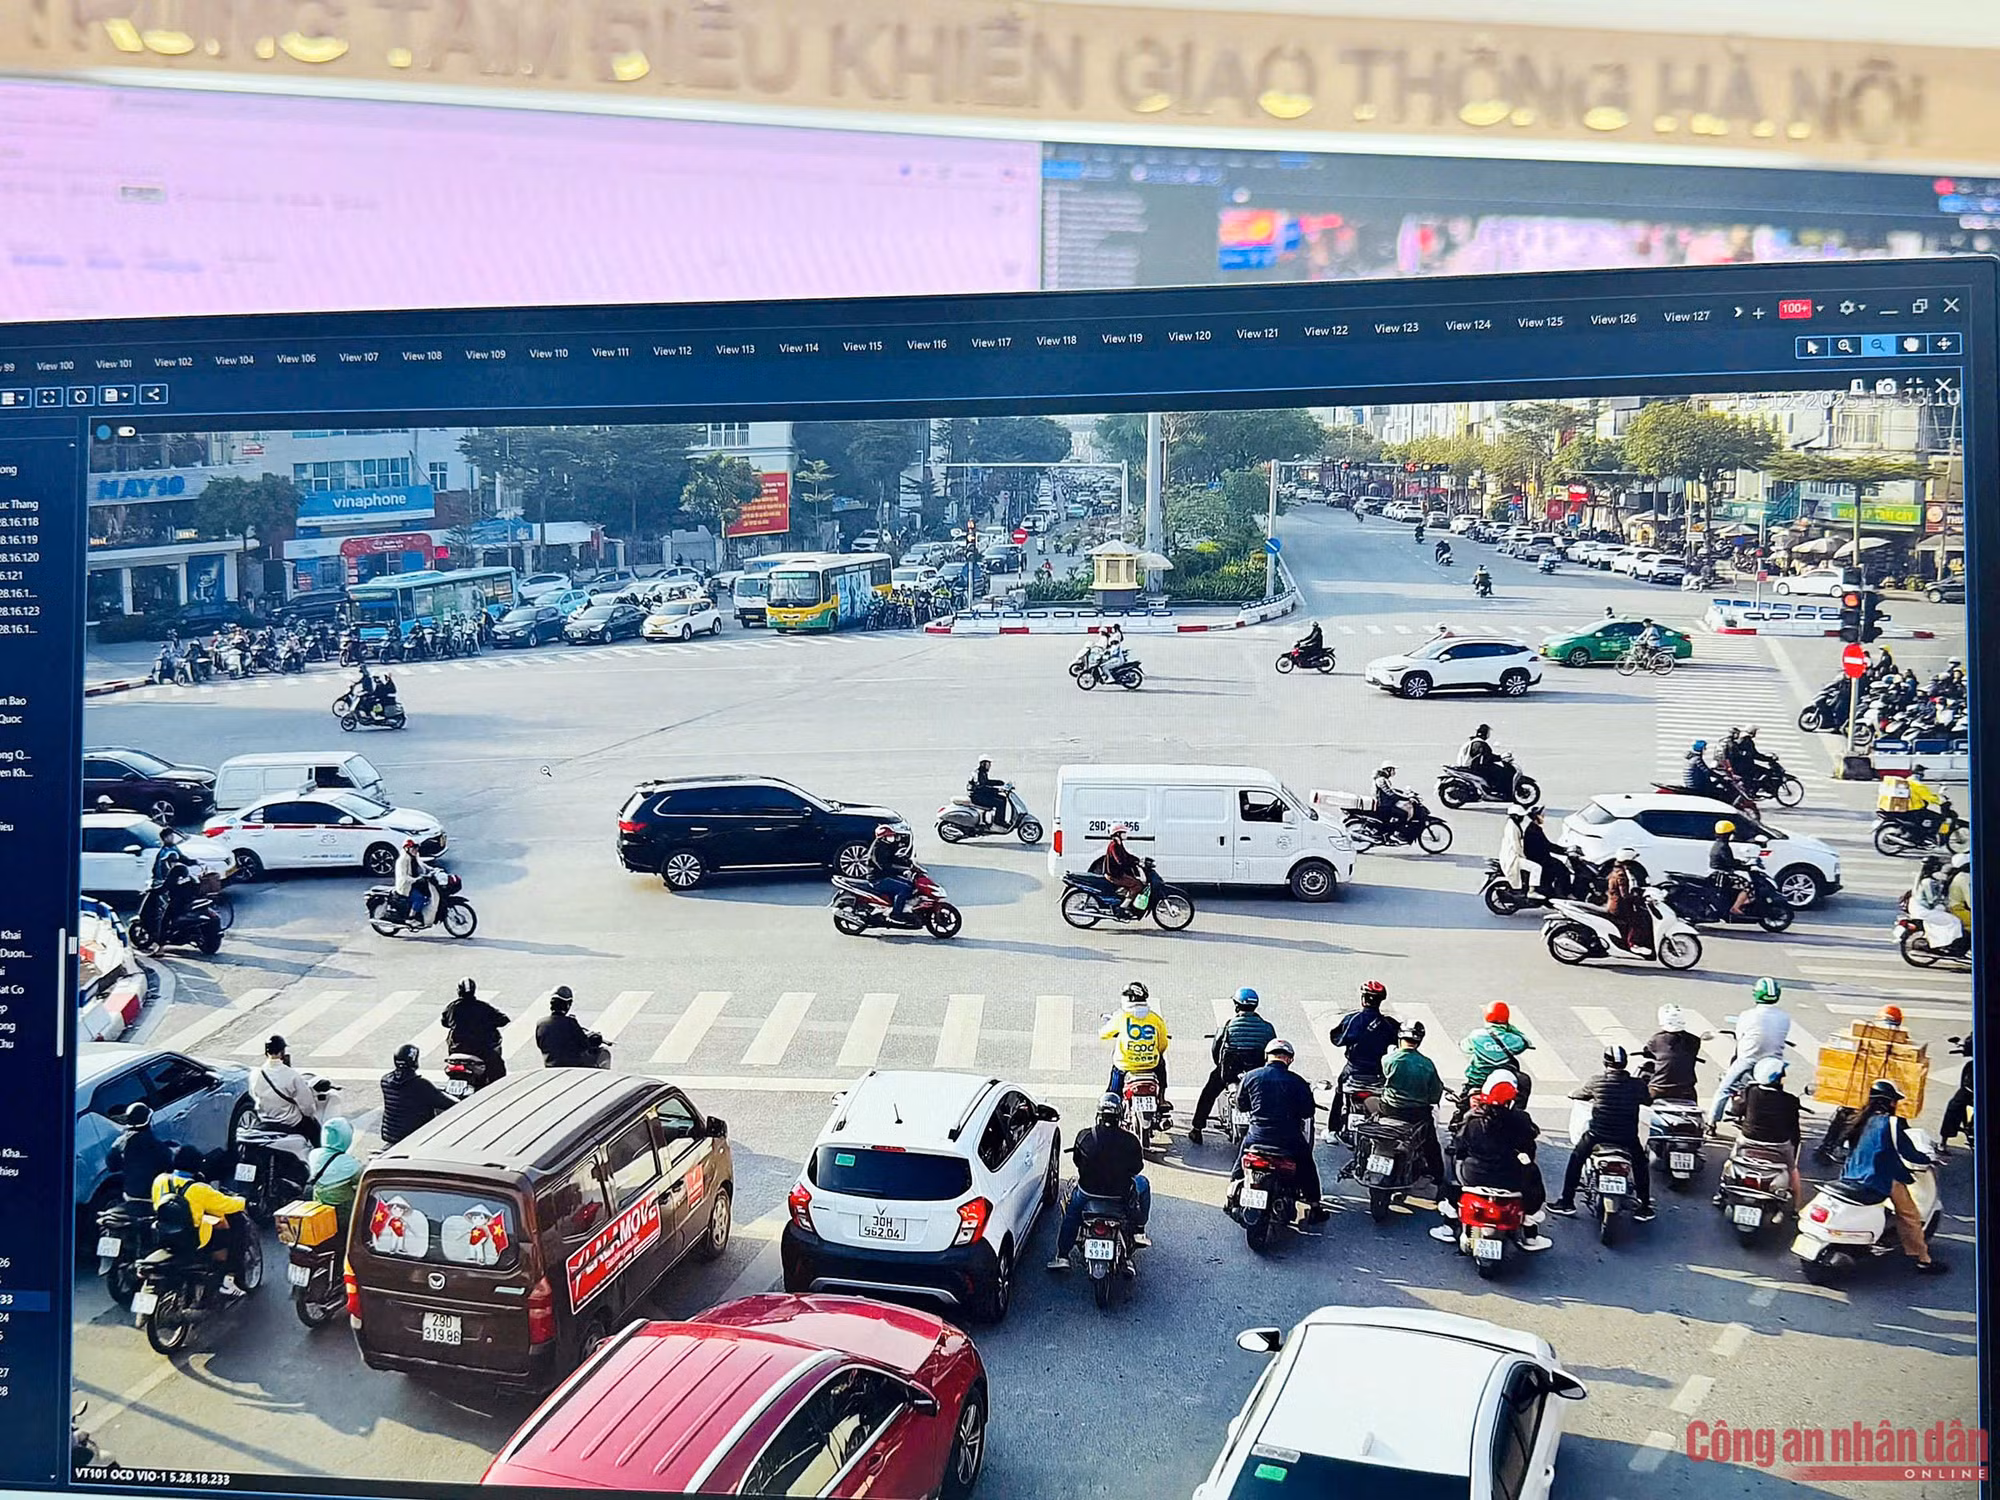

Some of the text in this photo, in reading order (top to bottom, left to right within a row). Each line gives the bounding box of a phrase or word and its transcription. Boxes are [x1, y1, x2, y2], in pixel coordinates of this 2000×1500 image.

[1114, 38, 1318, 120] GIAO
[1337, 36, 1632, 131] THÔNG
[1654, 34, 1764, 134] HÀ
[1784, 54, 1930, 158] NỘI
[1781, 302, 1809, 315] 100+
[1590, 313, 1637, 325] View 126
[1663, 310, 1711, 322] View 127
[1445, 319, 1492, 331] View 124
[1517, 316, 1564, 328] View 125
[1236, 328, 1279, 339] View 121
[1304, 325, 1349, 337] View 122
[1374, 322, 1419, 334] View 123
[1036, 335, 1077, 346] View 118
[1101, 332, 1143, 344] View 119
[1168, 330, 1212, 342] View 120
[779, 342, 819, 353] View 114
[842, 341, 883, 352] View 115
[906, 339, 948, 350] View 116
[971, 337, 1012, 348] View 117
[465, 349, 507, 360] View 109
[529, 348, 569, 359] View 110
[591, 347, 629, 357] View 111
[652, 345, 693, 356] View 112
[715, 344, 756, 355] View 113
[214, 355, 255, 365] View 104
[276, 353, 317, 364] View 106
[338, 351, 379, 362] View 107
[401, 350, 443, 361] View 108
[36, 360, 75, 371] View 100
[95, 358, 132, 369] View 101
[154, 356, 193, 367] View 102
[11, 499, 39, 512] Thang
[332, 492, 407, 509] vinaphone
[9, 696, 27, 706] Bao
[1, 930, 21, 940] Khai
[11, 985, 25, 995] Co
[1127, 1017, 1156, 1040] be
[1127, 1040, 1156, 1052] Food
[872, 1216, 893, 1227] 30H
[433, 1314, 452, 1328] 29D
[75, 1467, 230, 1485] VT101 OCD VIO-1 5.28.18.233
